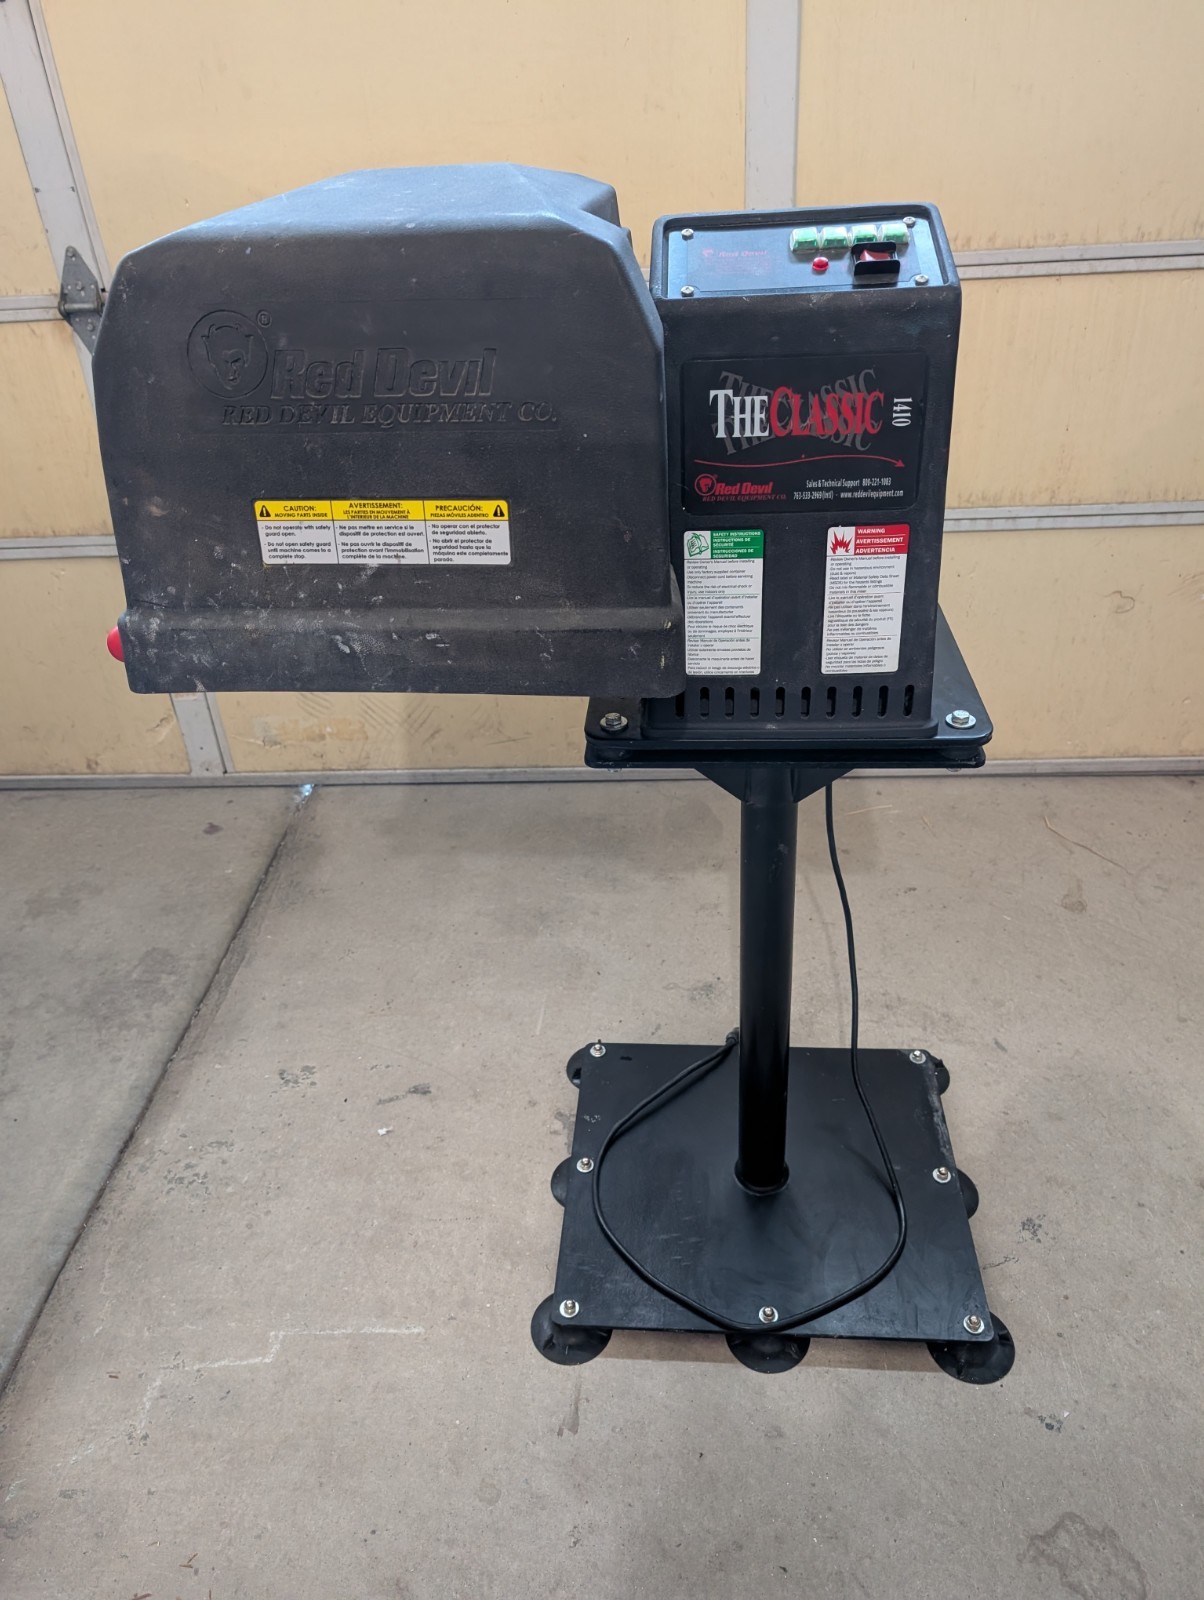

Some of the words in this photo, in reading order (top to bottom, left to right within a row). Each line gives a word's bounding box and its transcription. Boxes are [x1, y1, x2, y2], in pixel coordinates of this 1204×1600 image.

[270, 348, 365, 400] Red
[374, 346, 497, 398] Devil
[222, 404, 271, 426] RED
[279, 403, 356, 426] DEVIL
[361, 402, 512, 428] EQUIPMENT
[518, 401, 557, 422] CO.
[710, 389, 770, 438] THE
[770, 386, 884, 437] CLASSIC
[892, 397, 912, 427] 1410
[715, 482, 740, 495] Red
[741, 481, 773, 494] Devil
[806, 479, 817, 488] Sales
[822, 479, 842, 487] Technical
[842, 479, 860, 488] Support
